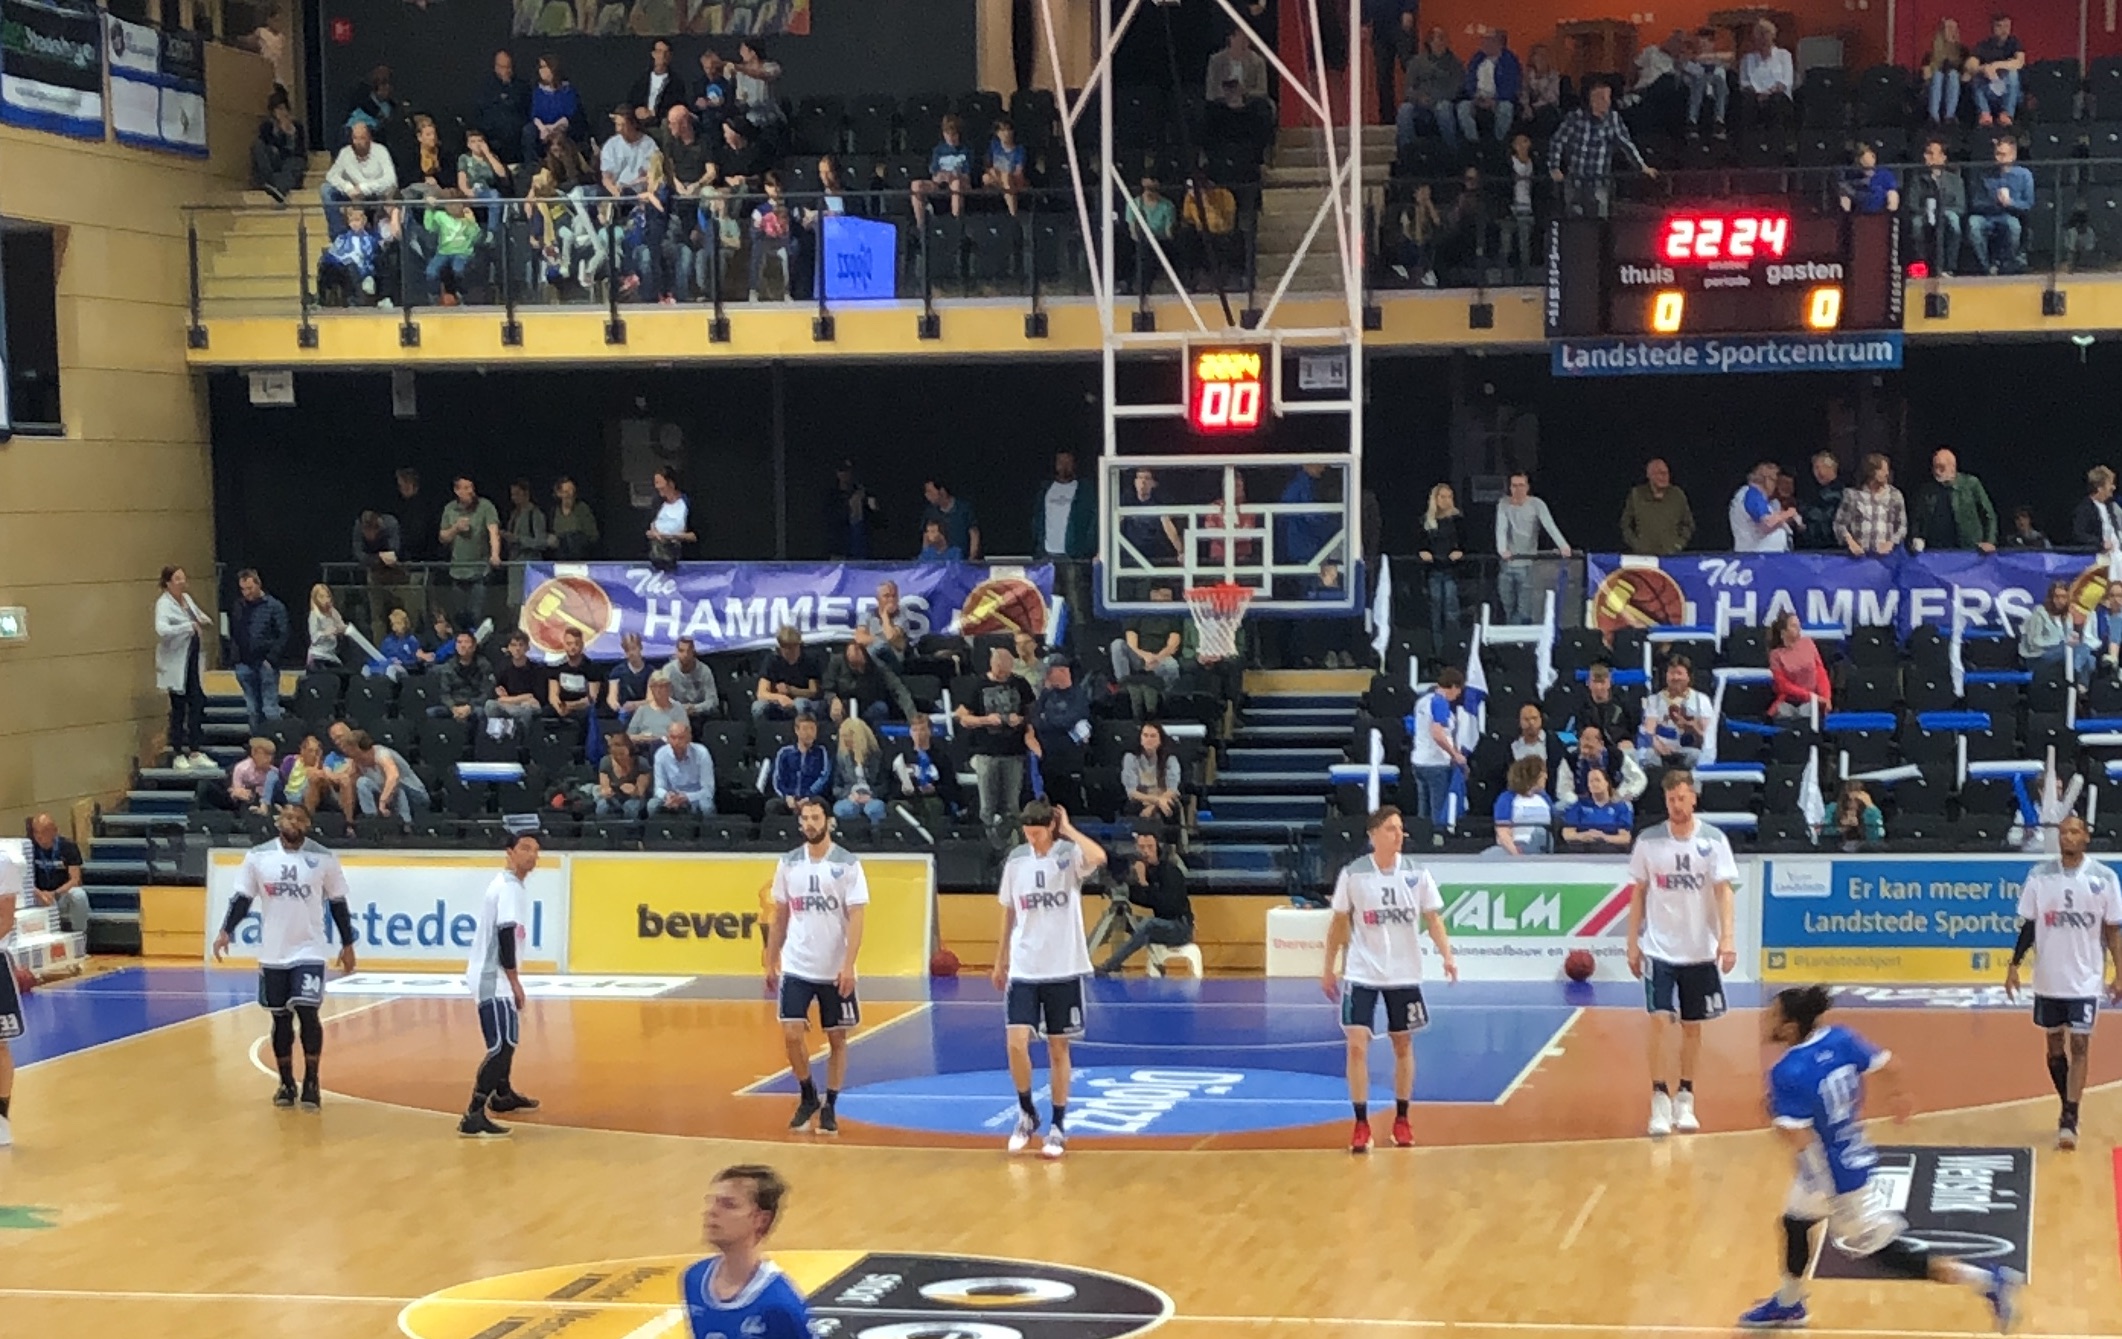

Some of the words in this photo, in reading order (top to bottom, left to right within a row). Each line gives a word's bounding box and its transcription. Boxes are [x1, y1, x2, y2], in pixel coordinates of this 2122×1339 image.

[1620, 264, 1675, 285] thuis
[1766, 261, 1844, 286] gasten
[1653, 291, 1684, 333] 0
[1810, 288, 1841, 329] 0
[1561, 340, 1699, 370] Landstede
[1704, 339, 1893, 373] Sportcentrum
[1200, 382, 1261, 428] 00
[626, 568, 678, 595] The
[1698, 557, 1754, 588] The
[280, 864, 298, 881] 34
[1675, 853, 1691, 871] 14
[808, 875, 820, 893] 11
[1381, 887, 1397, 906] 21
[1848, 877, 1873, 900] Er
[1879, 877, 1922, 900] kan
[1929, 881, 1993, 900] meer
[1803, 909, 1928, 934] Landstede
[1933, 909, 2025, 940] Sportce
